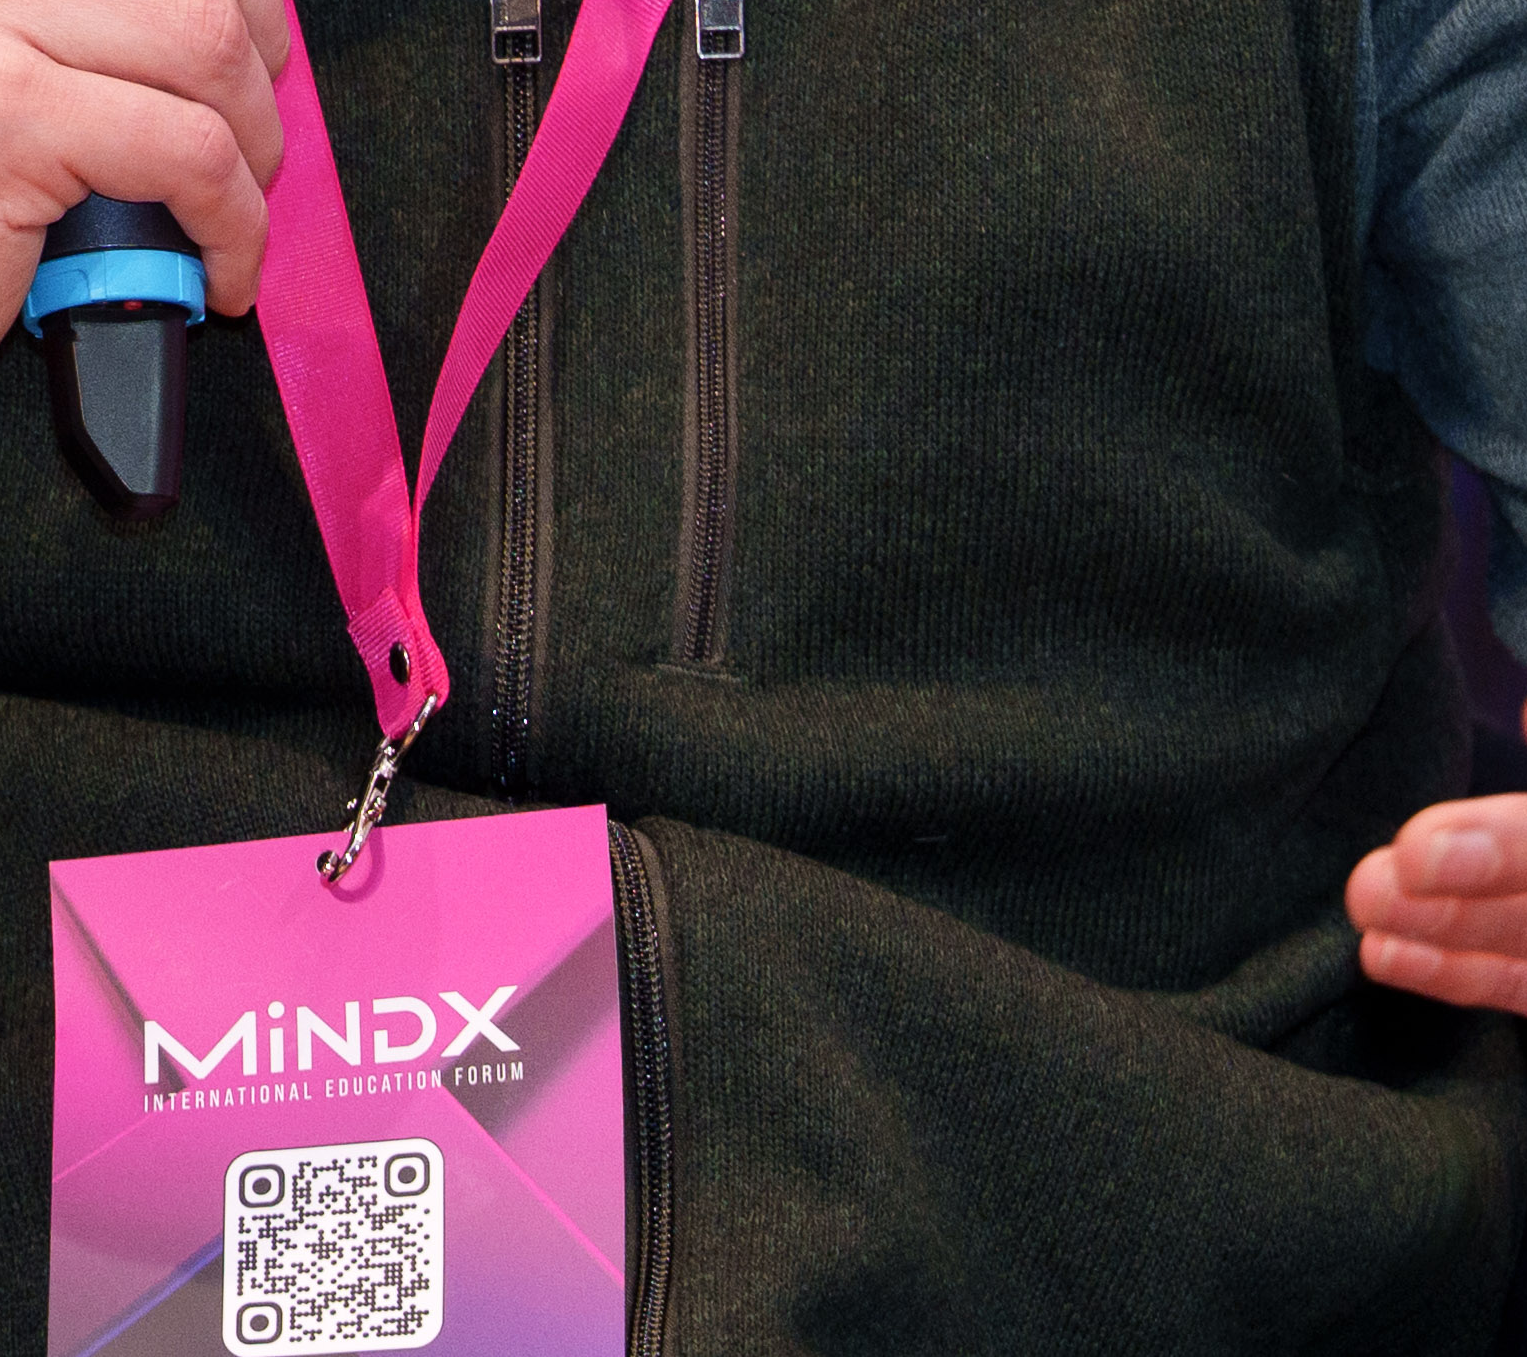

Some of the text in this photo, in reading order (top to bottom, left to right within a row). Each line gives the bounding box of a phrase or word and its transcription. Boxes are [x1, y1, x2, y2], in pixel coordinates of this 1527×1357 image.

[144, 1061, 524, 1113] INTERNATIONAL EDUCATION FORUM
